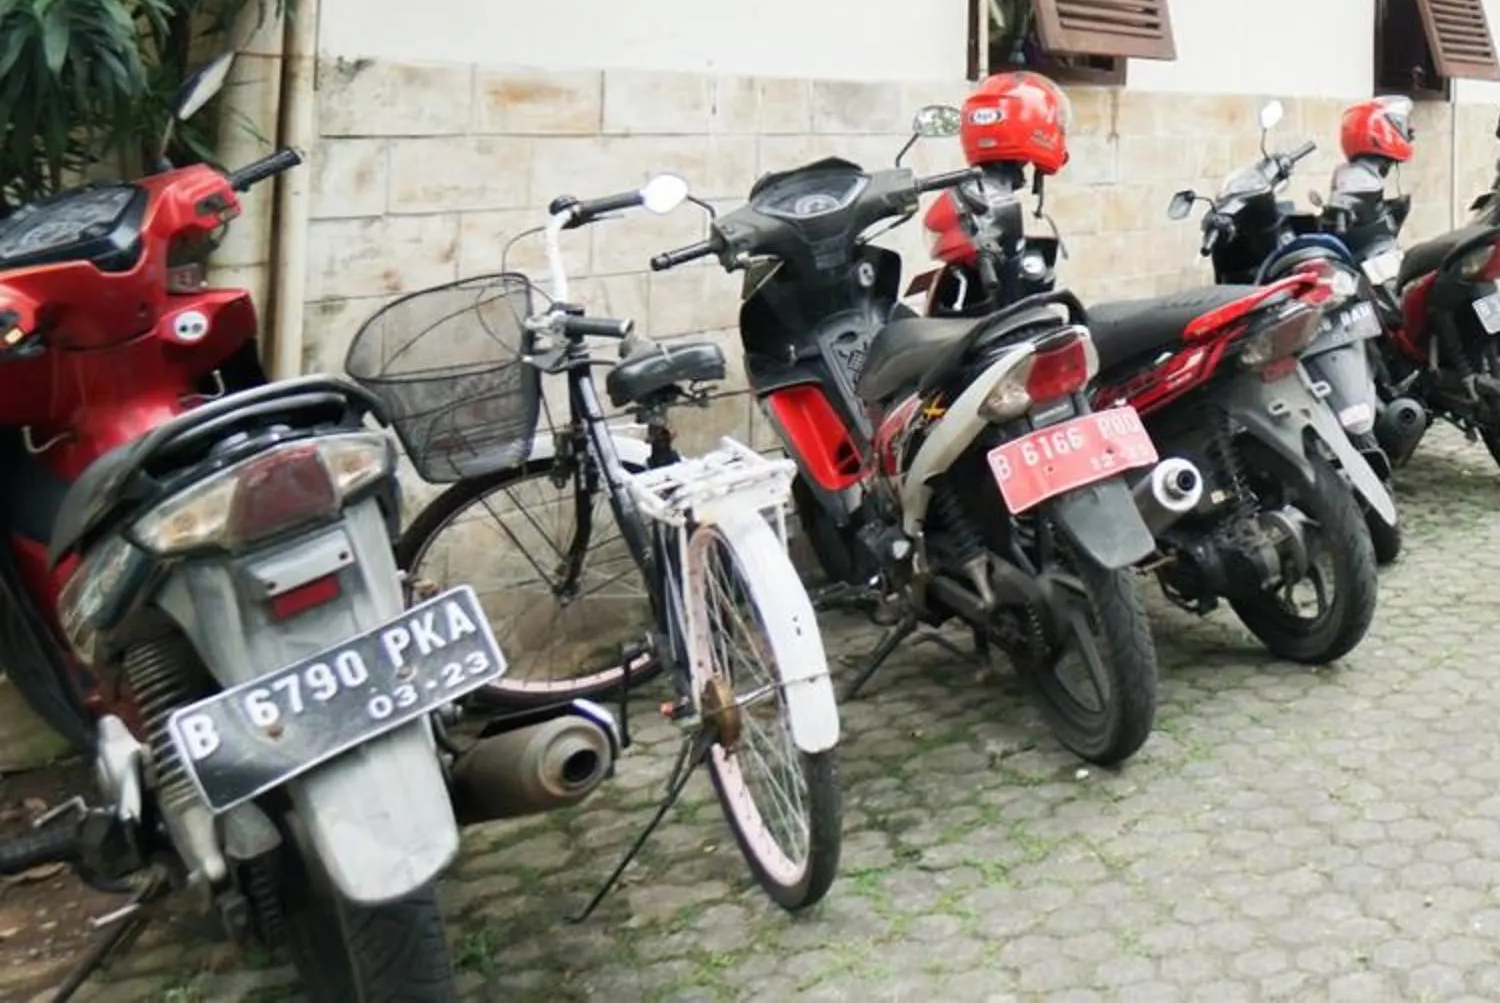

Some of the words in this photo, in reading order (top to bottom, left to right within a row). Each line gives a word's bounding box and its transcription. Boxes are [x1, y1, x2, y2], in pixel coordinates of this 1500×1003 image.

[993, 453, 1013, 482] B
[1020, 425, 1084, 467] 6166
[179, 712, 221, 761] B
[244, 649, 369, 728] 6790
[381, 601, 478, 667] PKA
